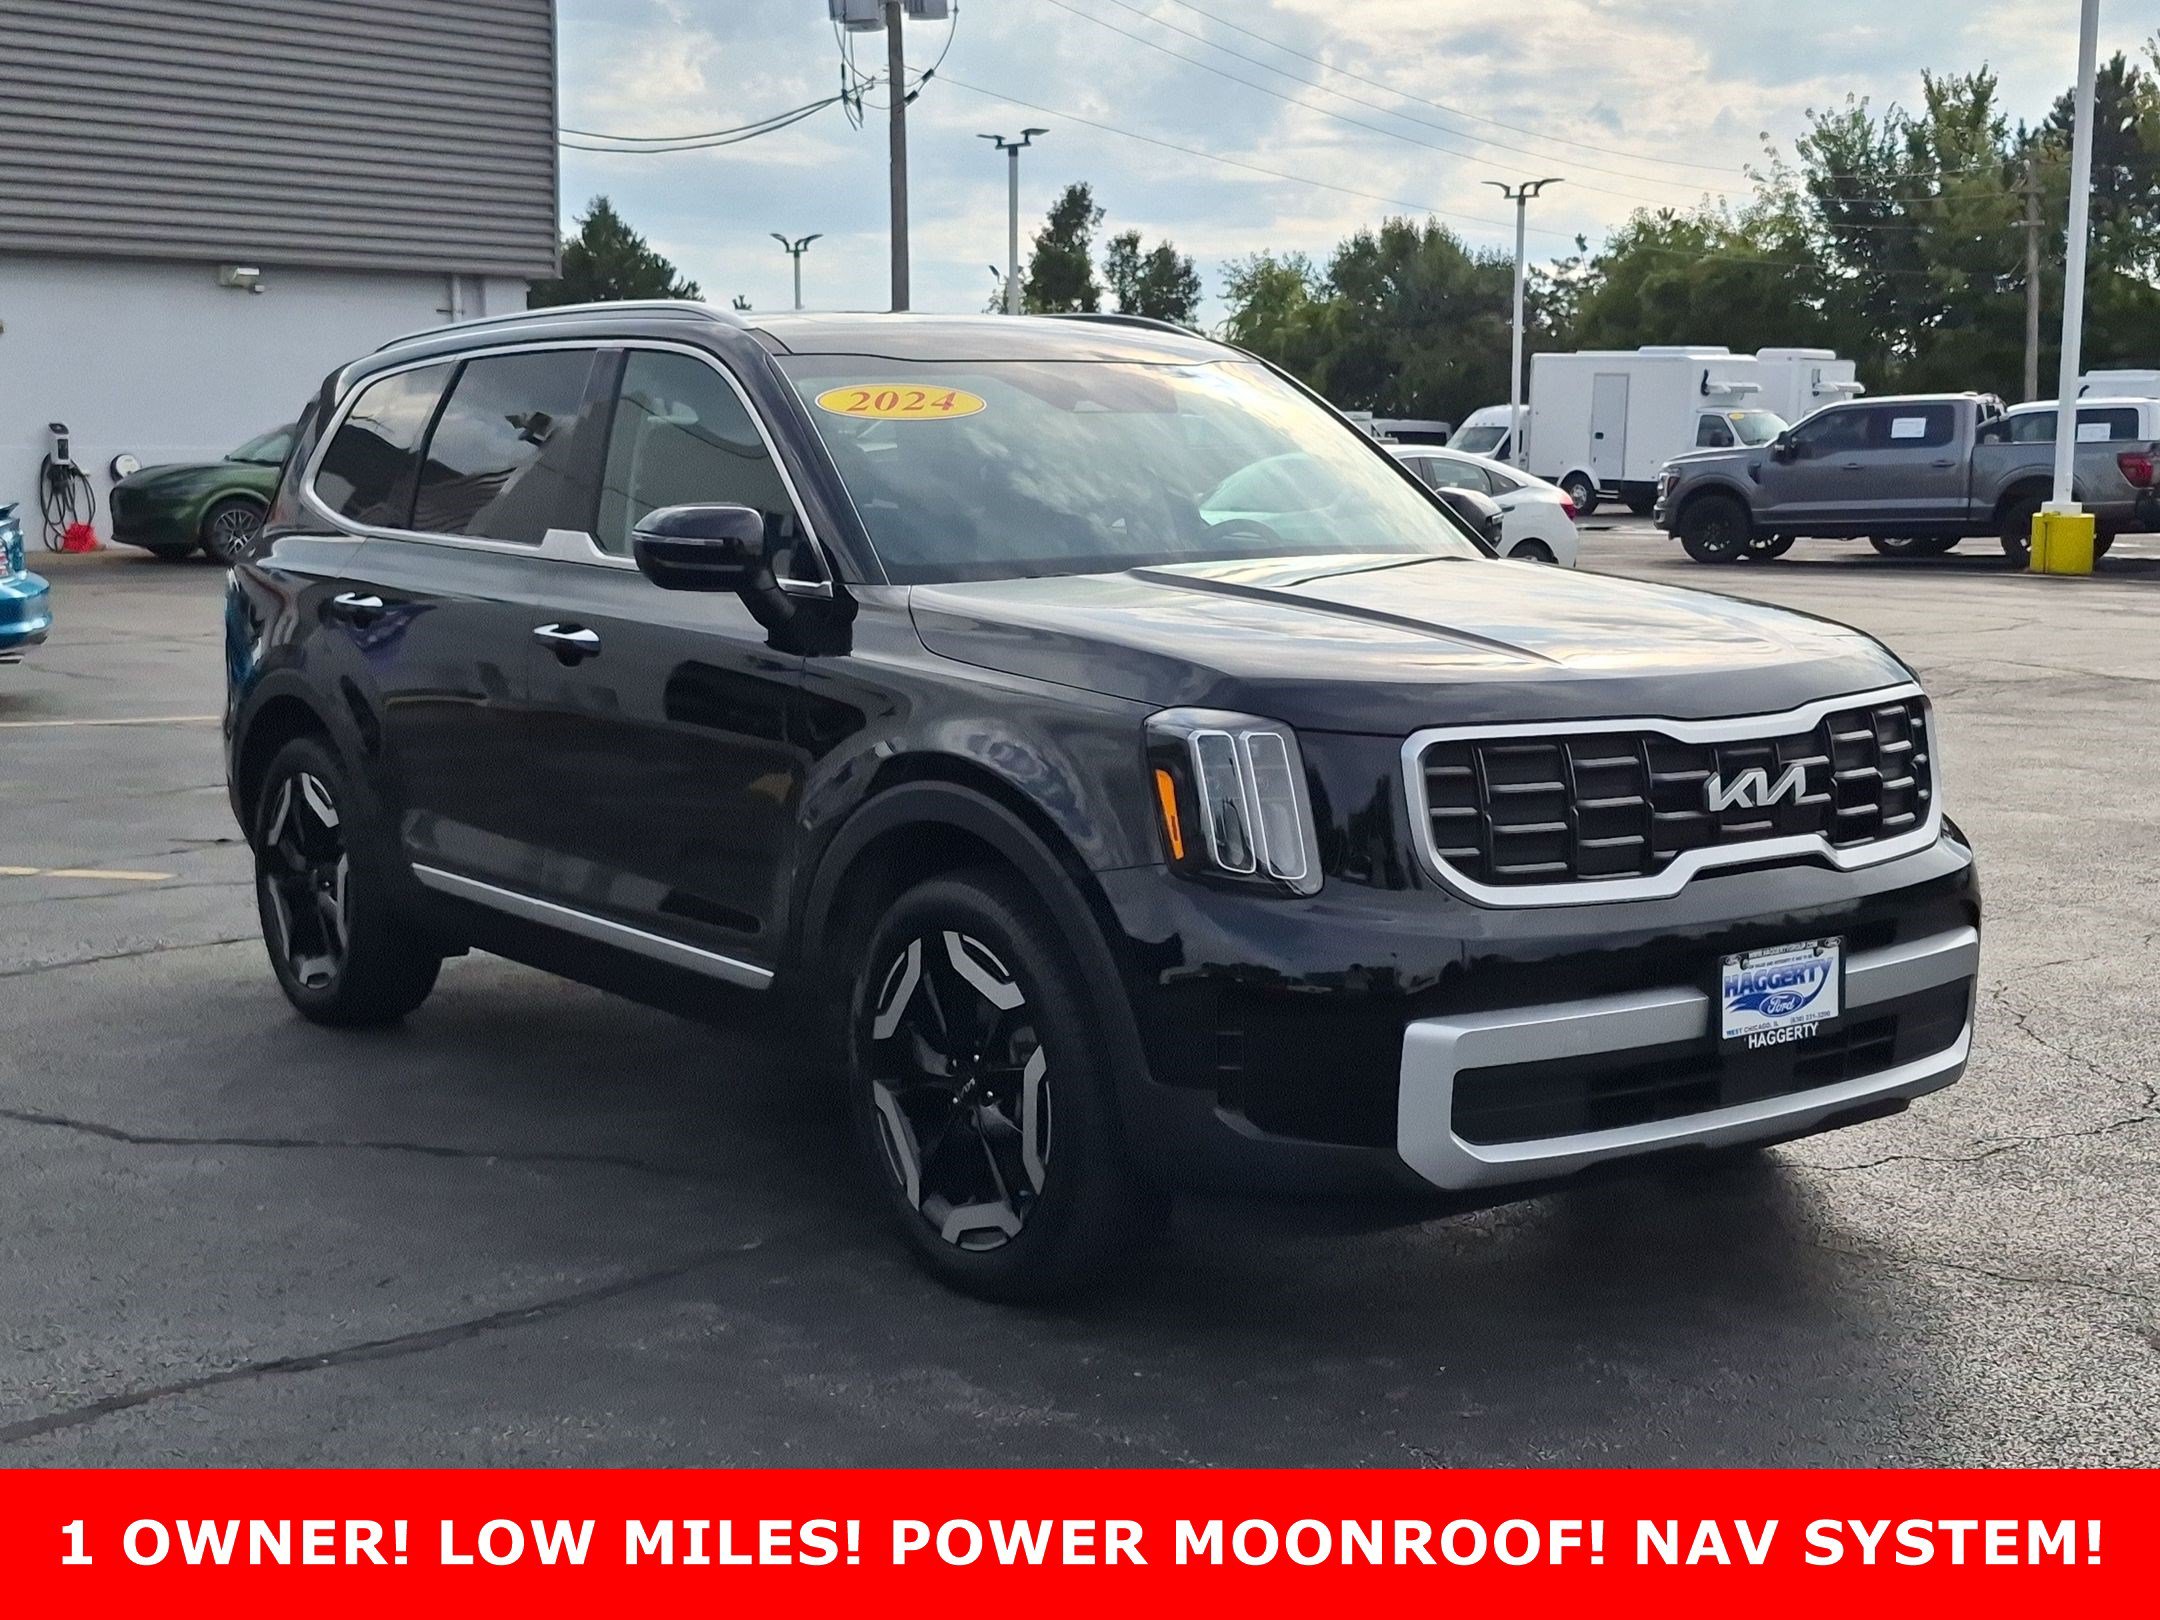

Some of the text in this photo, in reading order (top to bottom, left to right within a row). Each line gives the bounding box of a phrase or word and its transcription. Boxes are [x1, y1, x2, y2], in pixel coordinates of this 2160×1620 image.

[846, 390, 957, 412] 2024
[1704, 764, 1806, 812] KIA
[1724, 957, 1834, 998] HAGGERTY
[1767, 995, 1796, 1014] Ford
[1748, 1022, 1819, 1049] HAGGERTY
